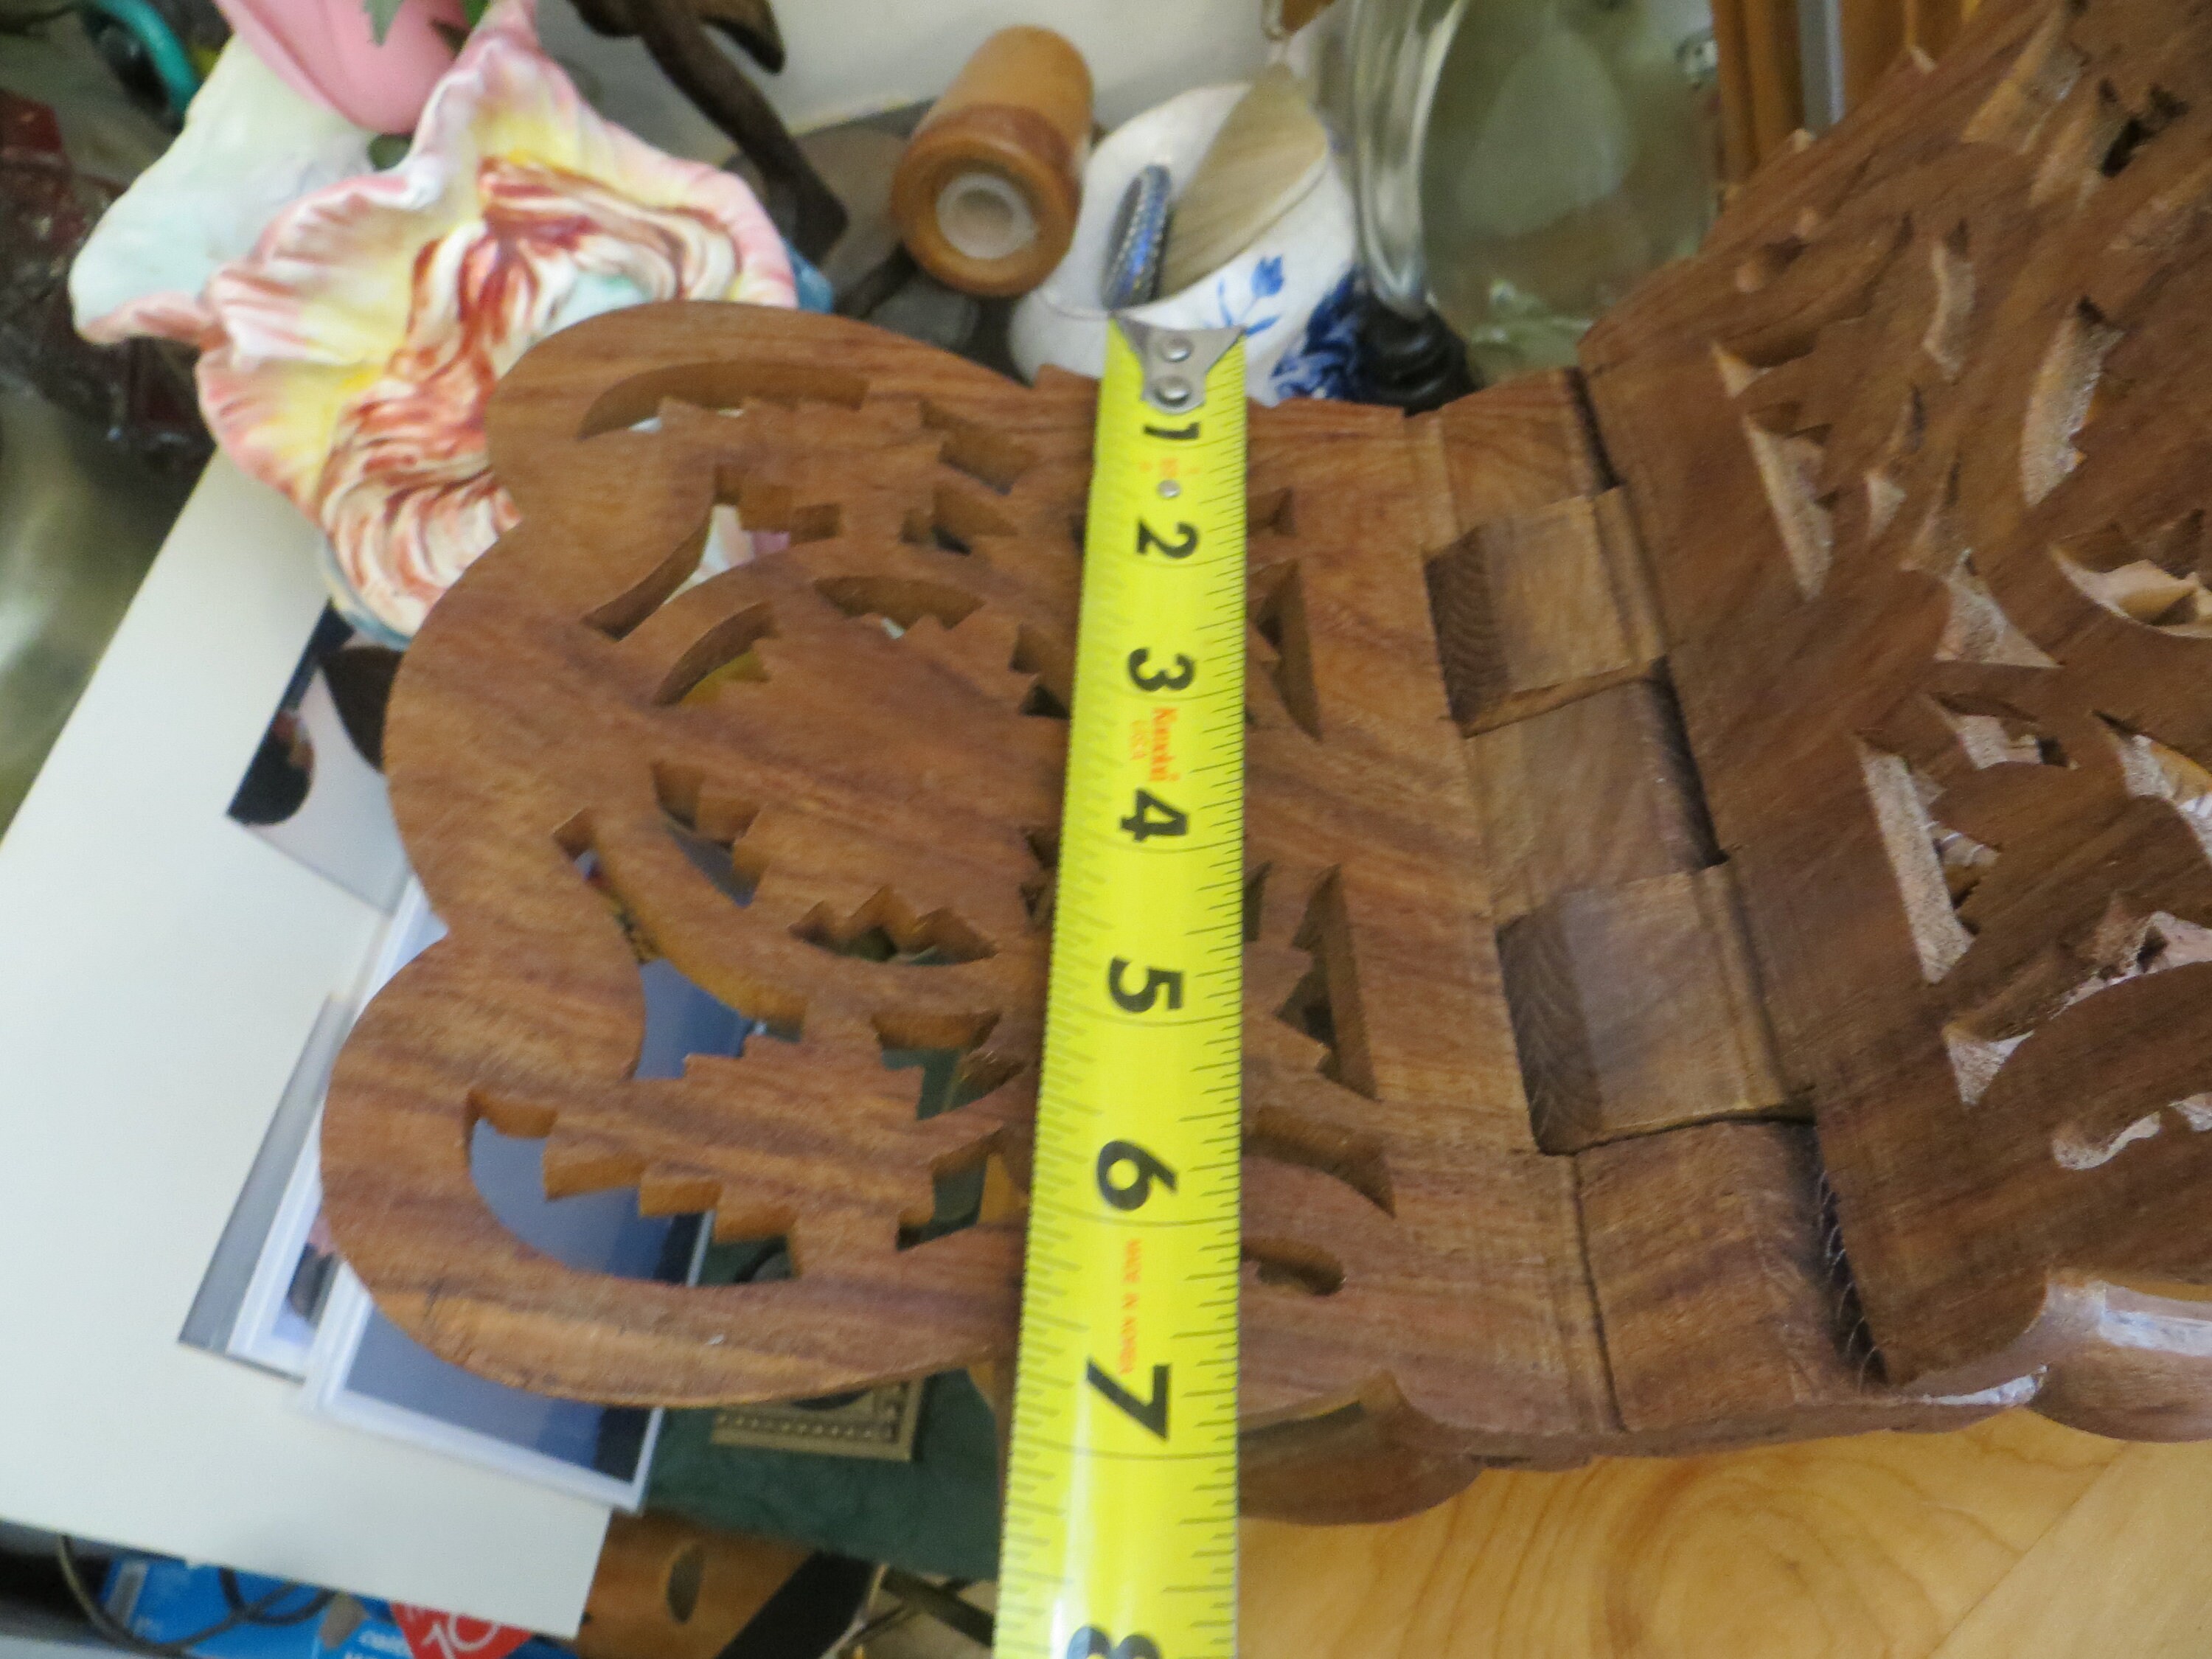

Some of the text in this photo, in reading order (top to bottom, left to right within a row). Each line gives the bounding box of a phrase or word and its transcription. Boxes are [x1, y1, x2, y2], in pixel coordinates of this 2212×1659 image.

[1144, 422, 1200, 441] 1
[1136, 522, 1199, 559] 2
[1128, 647, 1194, 692] 3
[1121, 790, 1188, 842] 4
[1108, 958, 1182, 1013] 5
[1097, 1140, 1176, 1211] 6
[1086, 1363, 1169, 1439] 7
